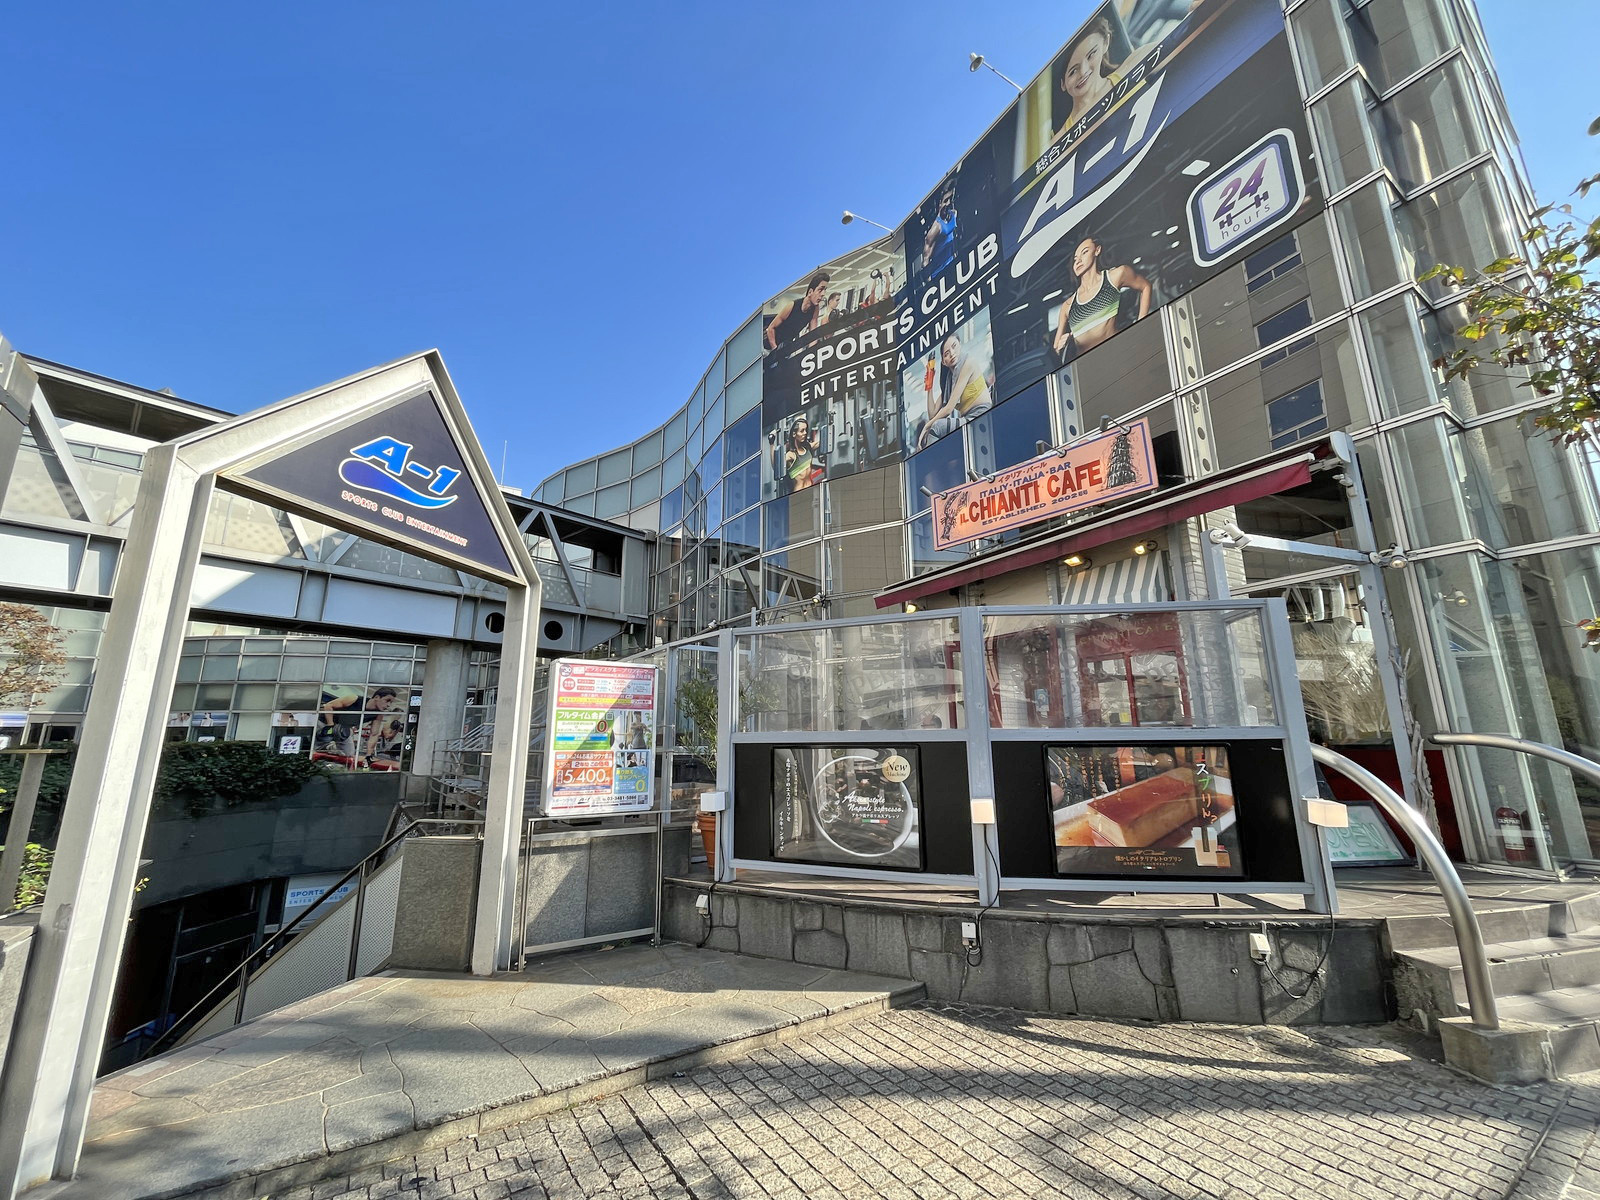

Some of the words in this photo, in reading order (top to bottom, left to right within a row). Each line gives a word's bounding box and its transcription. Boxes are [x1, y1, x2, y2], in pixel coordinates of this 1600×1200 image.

[1035, 44, 1163, 175] 総合スポーツクラブ
[1018, 70, 1166, 243] A-1
[1213, 158, 1267, 222] 24
[1221, 204, 1270, 239] hours
[800, 306, 914, 377] SPORTS
[921, 233, 999, 315] CLUB
[800, 273, 999, 406] ENTERTAINMENT
[349, 435, 462, 496] A-1
[960, 513, 969, 524] IL
[969, 481, 1041, 523] CHIANTI
[1047, 459, 1102, 498] CAFE
[1050, 461, 1071, 474] BAR
[341, 490, 378, 512] SPORTS
[382, 506, 404, 522] CLUB
[406, 516, 468, 547] ENTERTAINMENT
[982, 502, 1047, 525] ESTABLISHED
[887, 761, 908, 771] New
[290, 889, 325, 898] SPORTS
